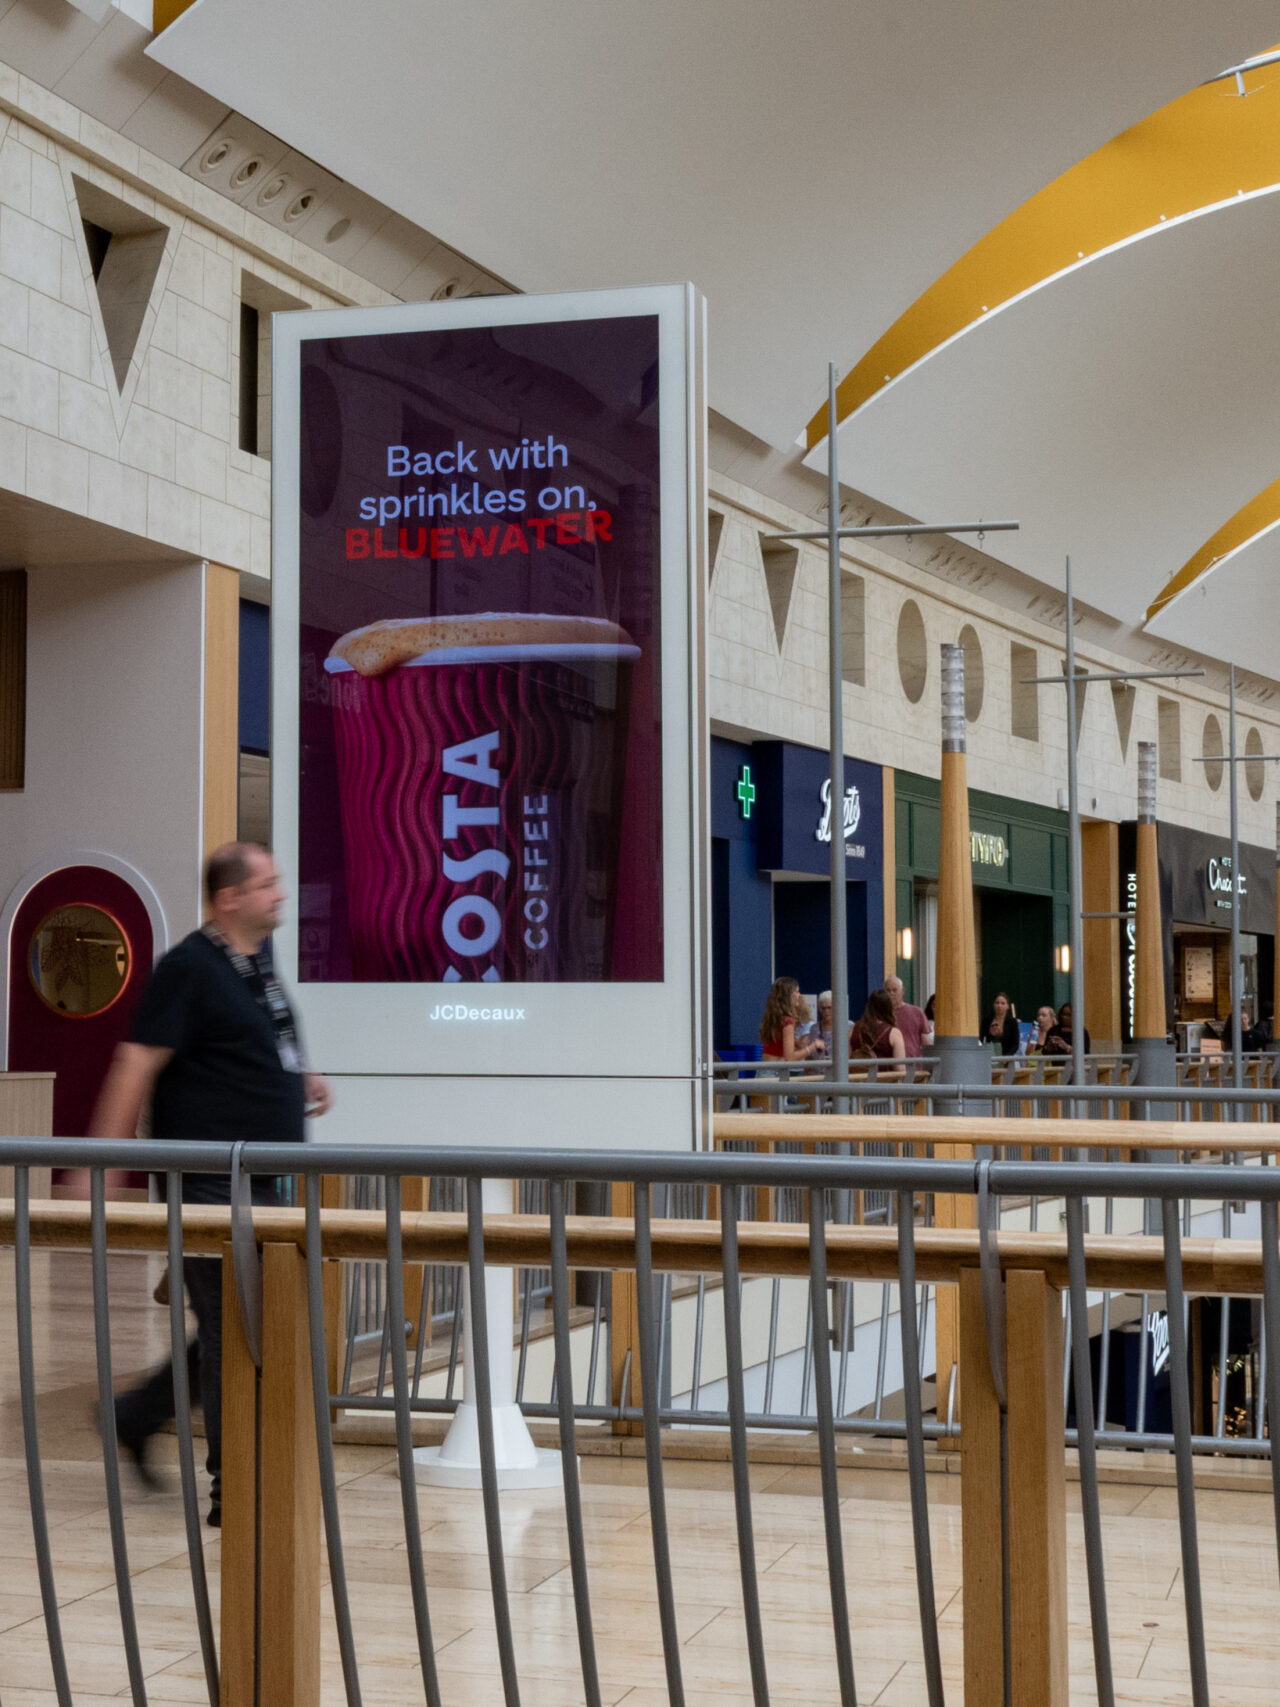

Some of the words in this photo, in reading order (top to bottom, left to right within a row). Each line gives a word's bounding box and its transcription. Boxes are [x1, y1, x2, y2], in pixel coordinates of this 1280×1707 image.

[387, 440, 478, 477] Back
[488, 435, 569, 471] with
[359, 482, 527, 526] sprinkles
[537, 485, 597, 512] on,
[345, 509, 613, 560] BLUEWATER
[442, 730, 510, 983] OSTA
[523, 794, 549, 952] COFFEE
[429, 1004, 526, 1021] JCDecaux
